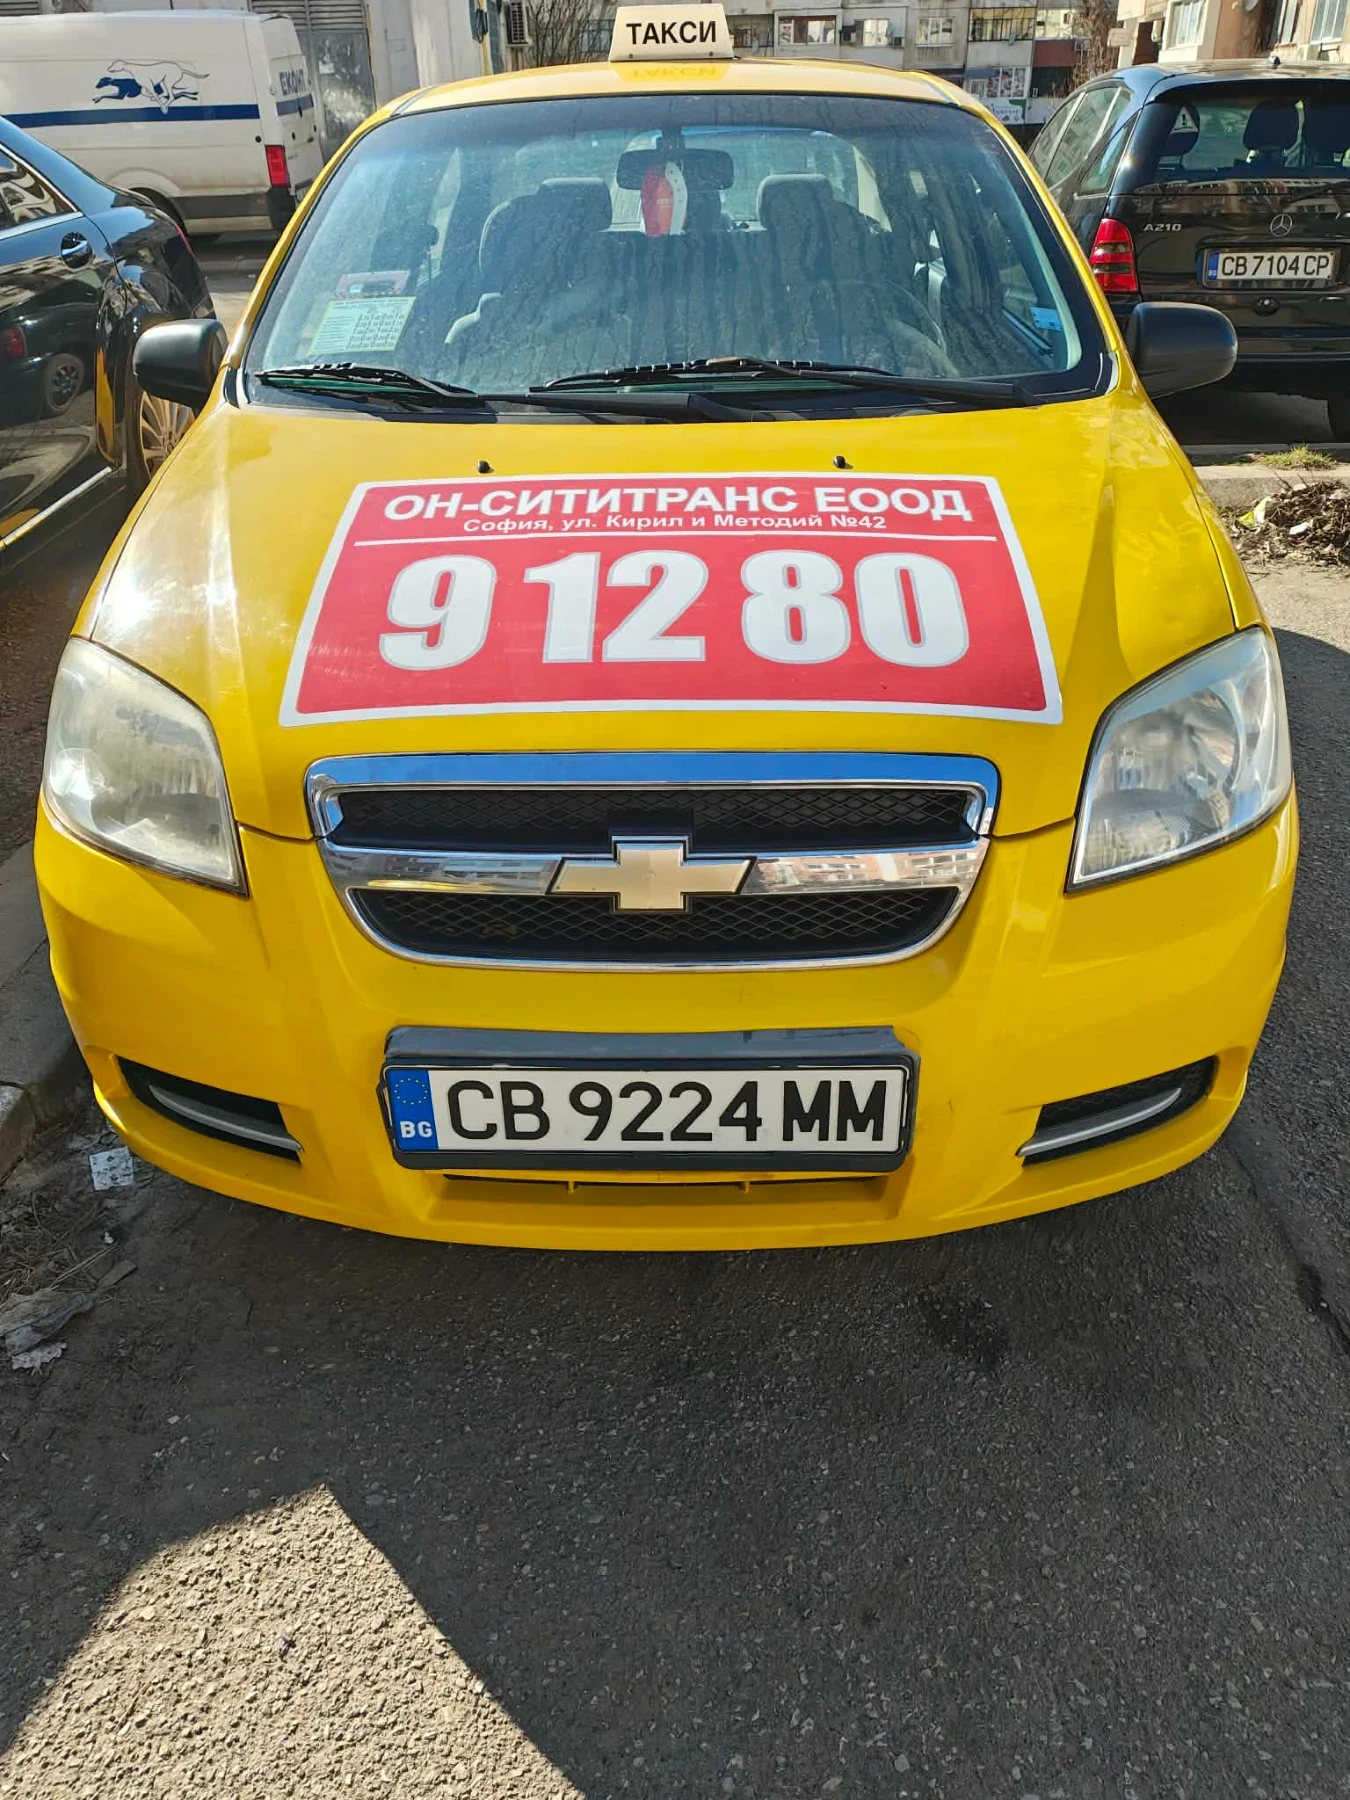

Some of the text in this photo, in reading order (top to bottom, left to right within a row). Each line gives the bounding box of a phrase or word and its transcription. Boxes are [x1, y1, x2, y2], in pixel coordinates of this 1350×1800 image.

[626, 20, 716, 45] ТАКСИ
[1143, 223, 1182, 232] A210
[1221, 255, 1330, 276] CB 7104 CP
[384, 486, 975, 522] ОН-СИТИТРАНС ЕООД
[463, 514, 887, 534] София, ул. Кирил и Методий №42
[379, 549, 970, 671] 9 12 80
[447, 1079, 887, 1142] CB 9224 MM
[400, 1120, 433, 1139] BG
